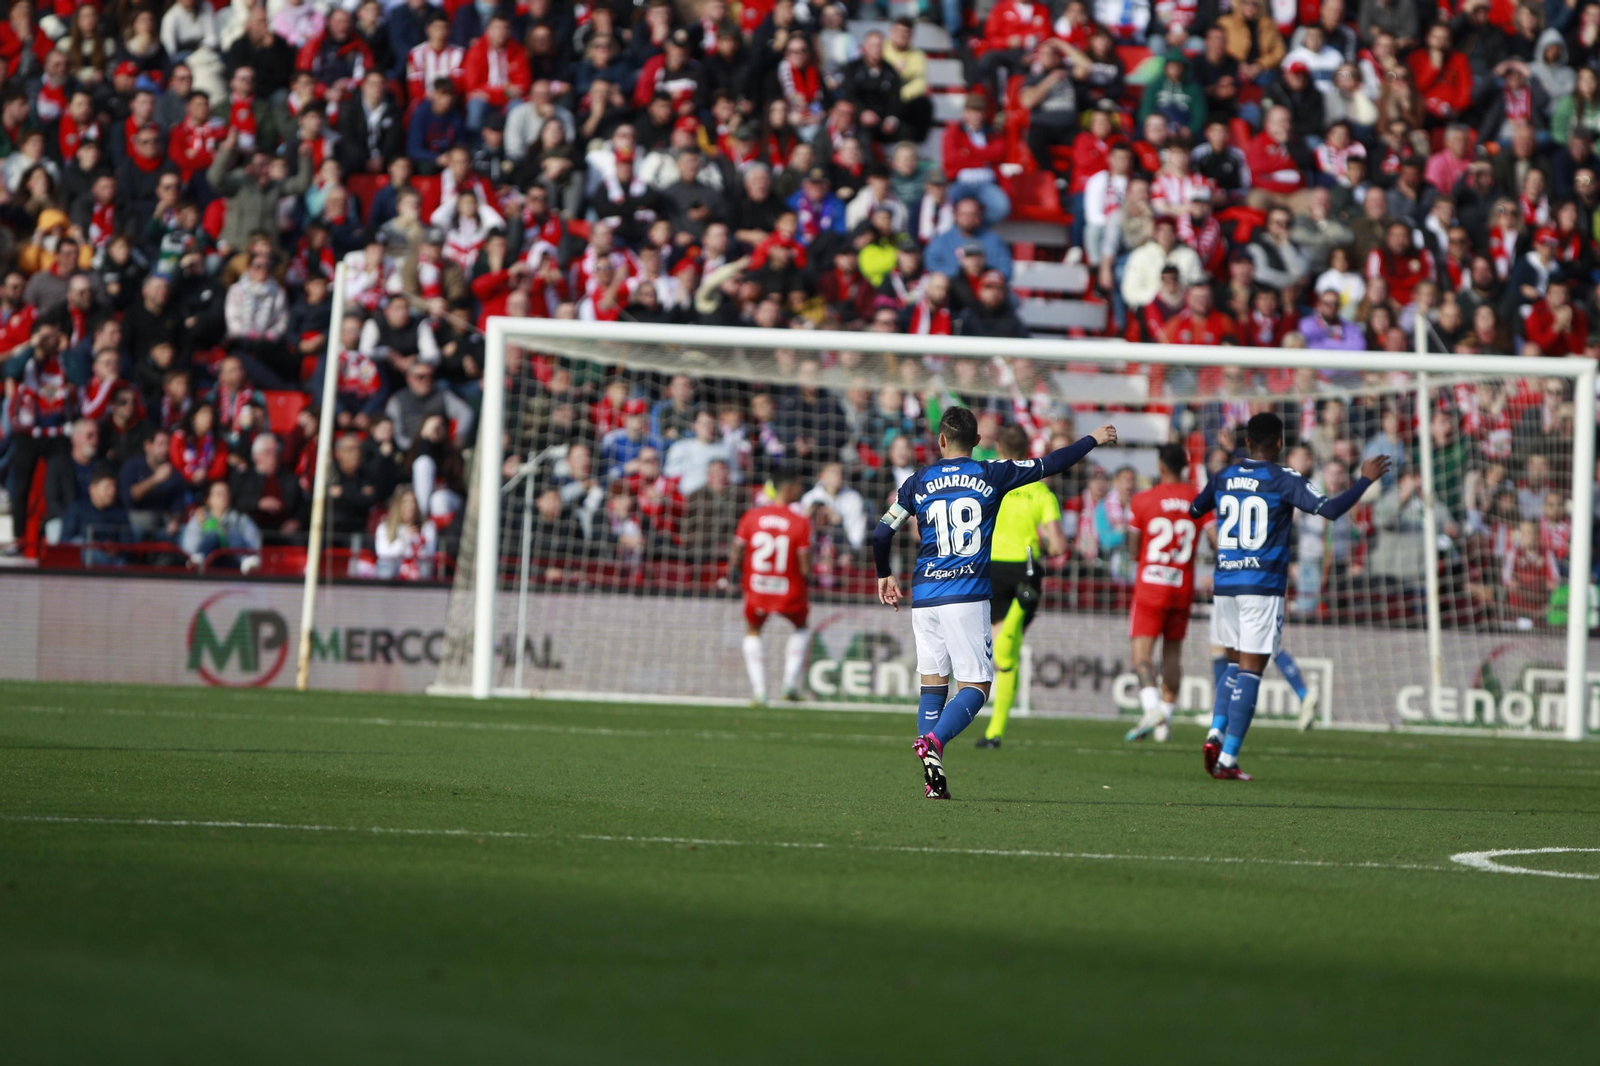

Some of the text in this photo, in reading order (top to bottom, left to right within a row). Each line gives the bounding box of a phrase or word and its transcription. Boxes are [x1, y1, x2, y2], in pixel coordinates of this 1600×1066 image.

[914, 492, 927, 504] A.
[925, 475, 994, 498] GUARDADO
[1226, 477, 1260, 492] ABNER
[926, 497, 983, 559] 18
[1147, 517, 1196, 564] 23
[1218, 494, 1269, 552] 20
[750, 530, 790, 573] 21
[187, 608, 288, 672] MP
